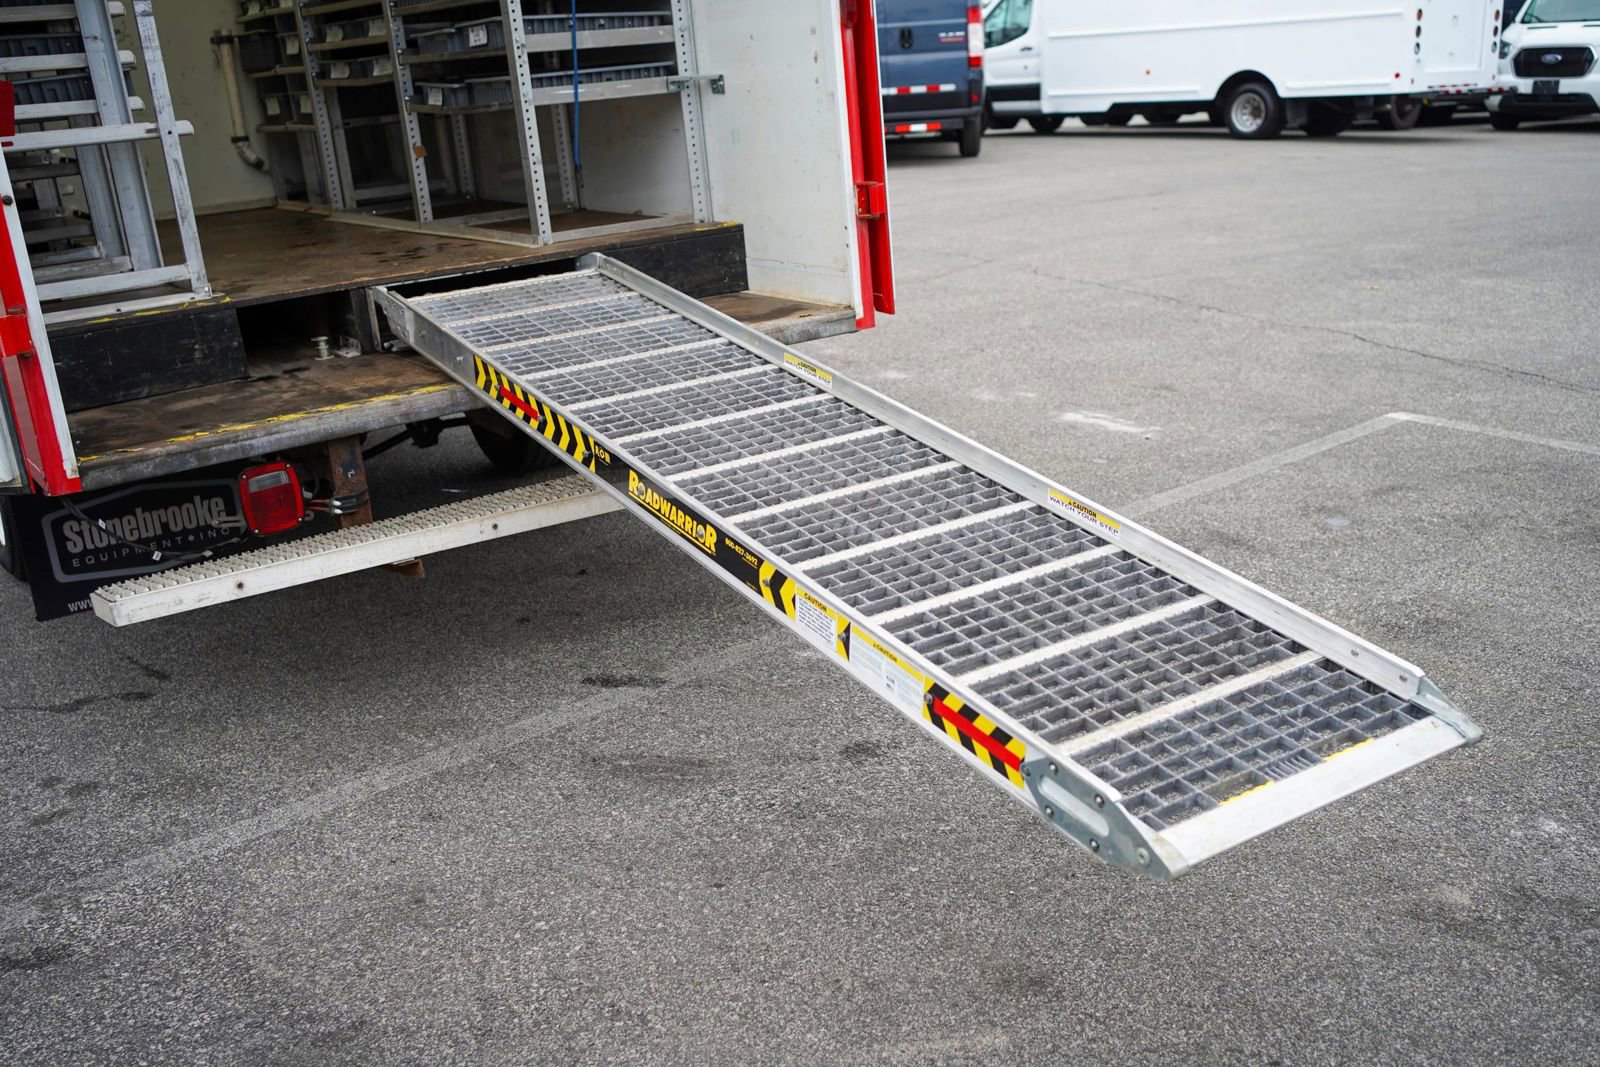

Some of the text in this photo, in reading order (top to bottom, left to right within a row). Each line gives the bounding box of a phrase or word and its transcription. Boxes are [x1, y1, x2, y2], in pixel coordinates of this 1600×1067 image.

[62, 495, 227, 554] Stonebrooke
[628, 469, 718, 552] ROADWARRIOR
[1049, 496, 1119, 535] WATCH YOUR STEP
[1072, 501, 1097, 518] CAUTION
[73, 535, 183, 568] EQUIPMENT
[804, 592, 827, 612] CAUTION
[876, 644, 898, 663] CAUTION
